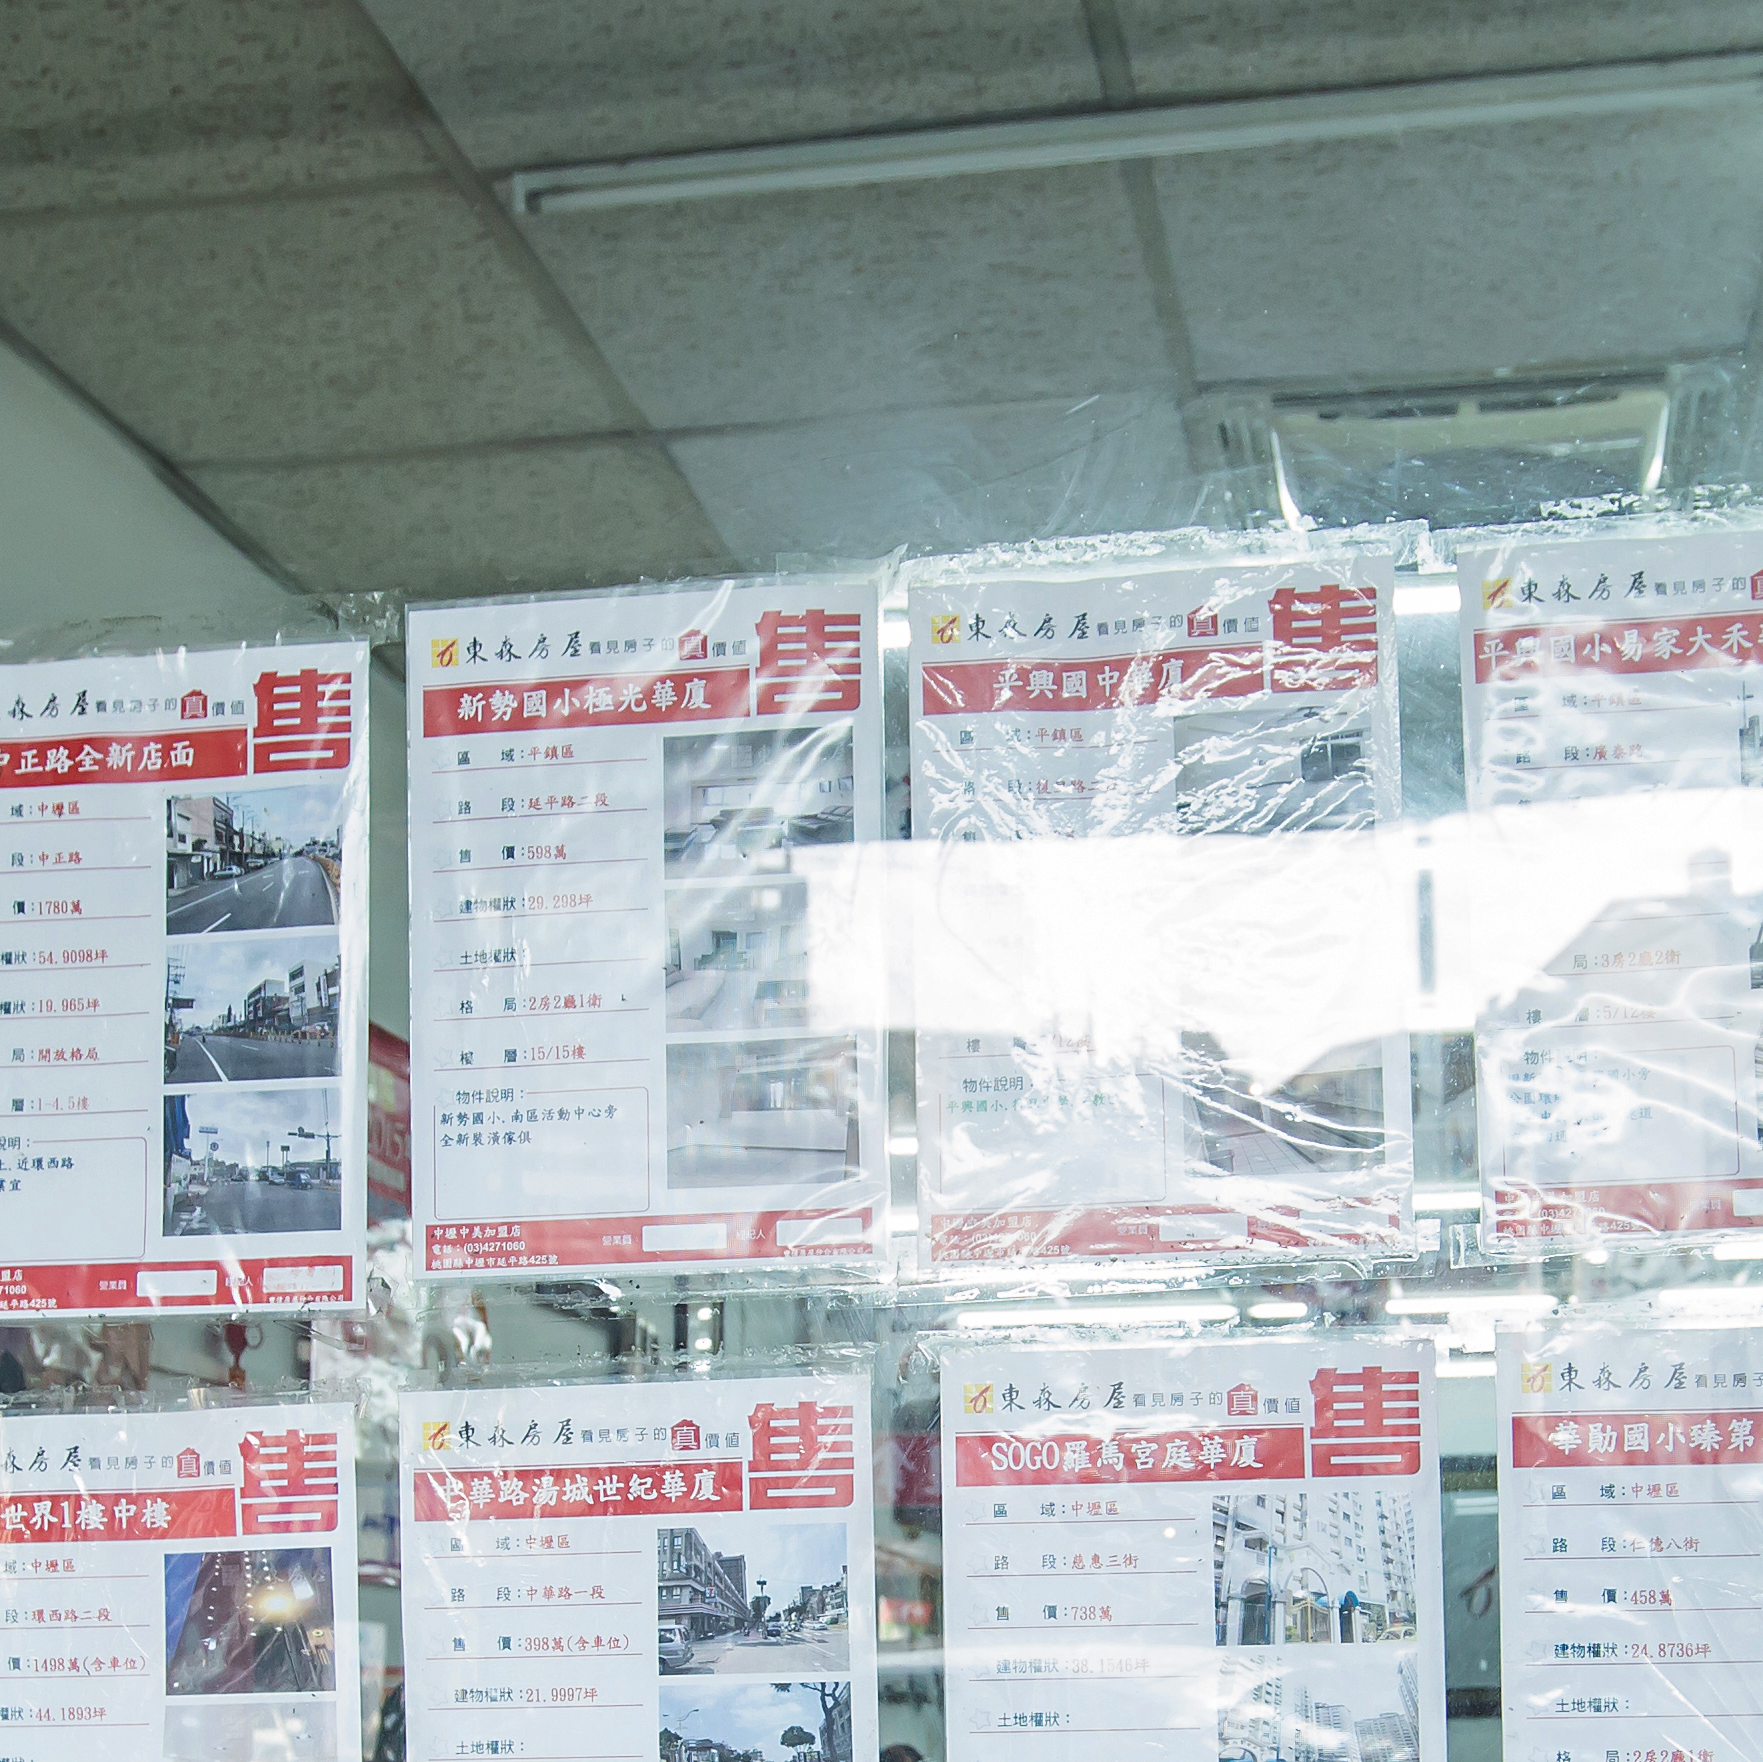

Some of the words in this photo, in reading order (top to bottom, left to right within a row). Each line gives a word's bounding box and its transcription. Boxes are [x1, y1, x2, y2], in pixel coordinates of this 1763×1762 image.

[1522, 569, 1649, 604] 東森房屋
[464, 630, 584, 666] 東森房屋
[589, 629, 748, 660] 看見房子的真價值
[1267, 583, 1378, 692] 售
[755, 608, 861, 716] 售
[457, 677, 712, 723] 新勢國小極光華廈
[252, 668, 352, 775] 售
[440, 1130, 532, 1148] 全新裝潢傢俱
[1559, 1361, 1689, 1393] 東森房屋
[1001, 1381, 1126, 1412] 東森房屋
[1132, 1383, 1301, 1416] 看見房子的真價值
[458, 1418, 574, 1447] 東森房屋
[580, 1419, 740, 1452] 看見房子的真價值
[1309, 1366, 1421, 1478] 售
[747, 1401, 854, 1511] 售
[990, 1435, 1265, 1473] SOGO羅馬宮庭華廈
[239, 1429, 338, 1535] 售
[438, 1470, 722, 1513] 中華路湯城世紀華廈
[0, 1498, 172, 1532] 世界1樓中樓
[997, 1711, 1071, 1728] 土地權狀：
[1555, 1696, 1630, 1714] 土地權狀：
[456, 1739, 525, 1755] 土地權狀：
